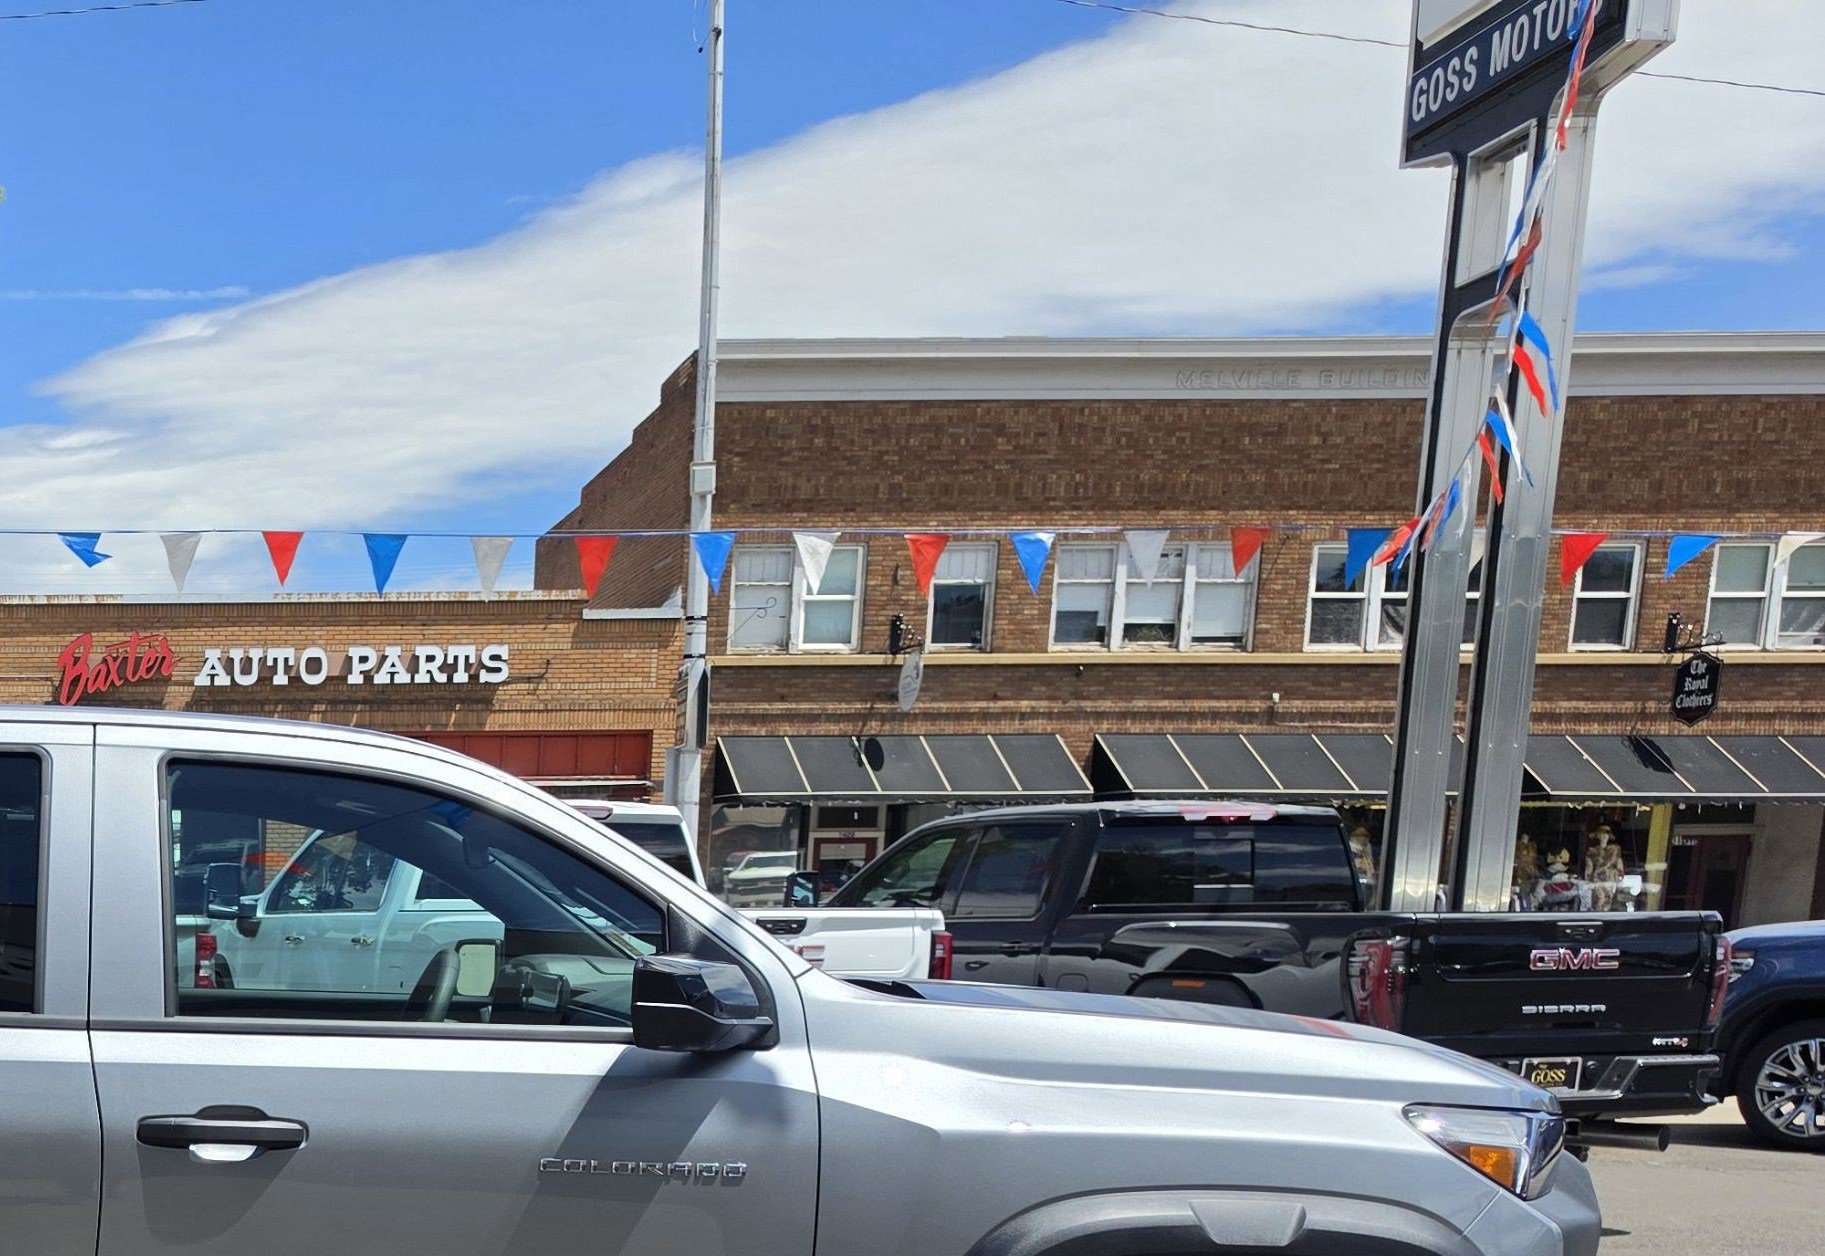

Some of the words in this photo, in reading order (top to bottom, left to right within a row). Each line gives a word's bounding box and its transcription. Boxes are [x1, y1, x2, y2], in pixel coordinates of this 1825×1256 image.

[1412, 46, 1478, 122] GOSS
[1489, 0, 1602, 77] MOTO
[1174, 369, 1303, 389] MELVILLE
[1318, 367, 1431, 388] BUILDIN
[56, 631, 182, 706] Baxter
[194, 646, 329, 686] AUTO
[347, 643, 510, 685] PARTS
[1530, 948, 1620, 970] GMC
[1522, 1004, 1606, 1014] SIERRA
[1531, 1069, 1566, 1083] GOSS
[540, 1157, 747, 1178] COLORADO
